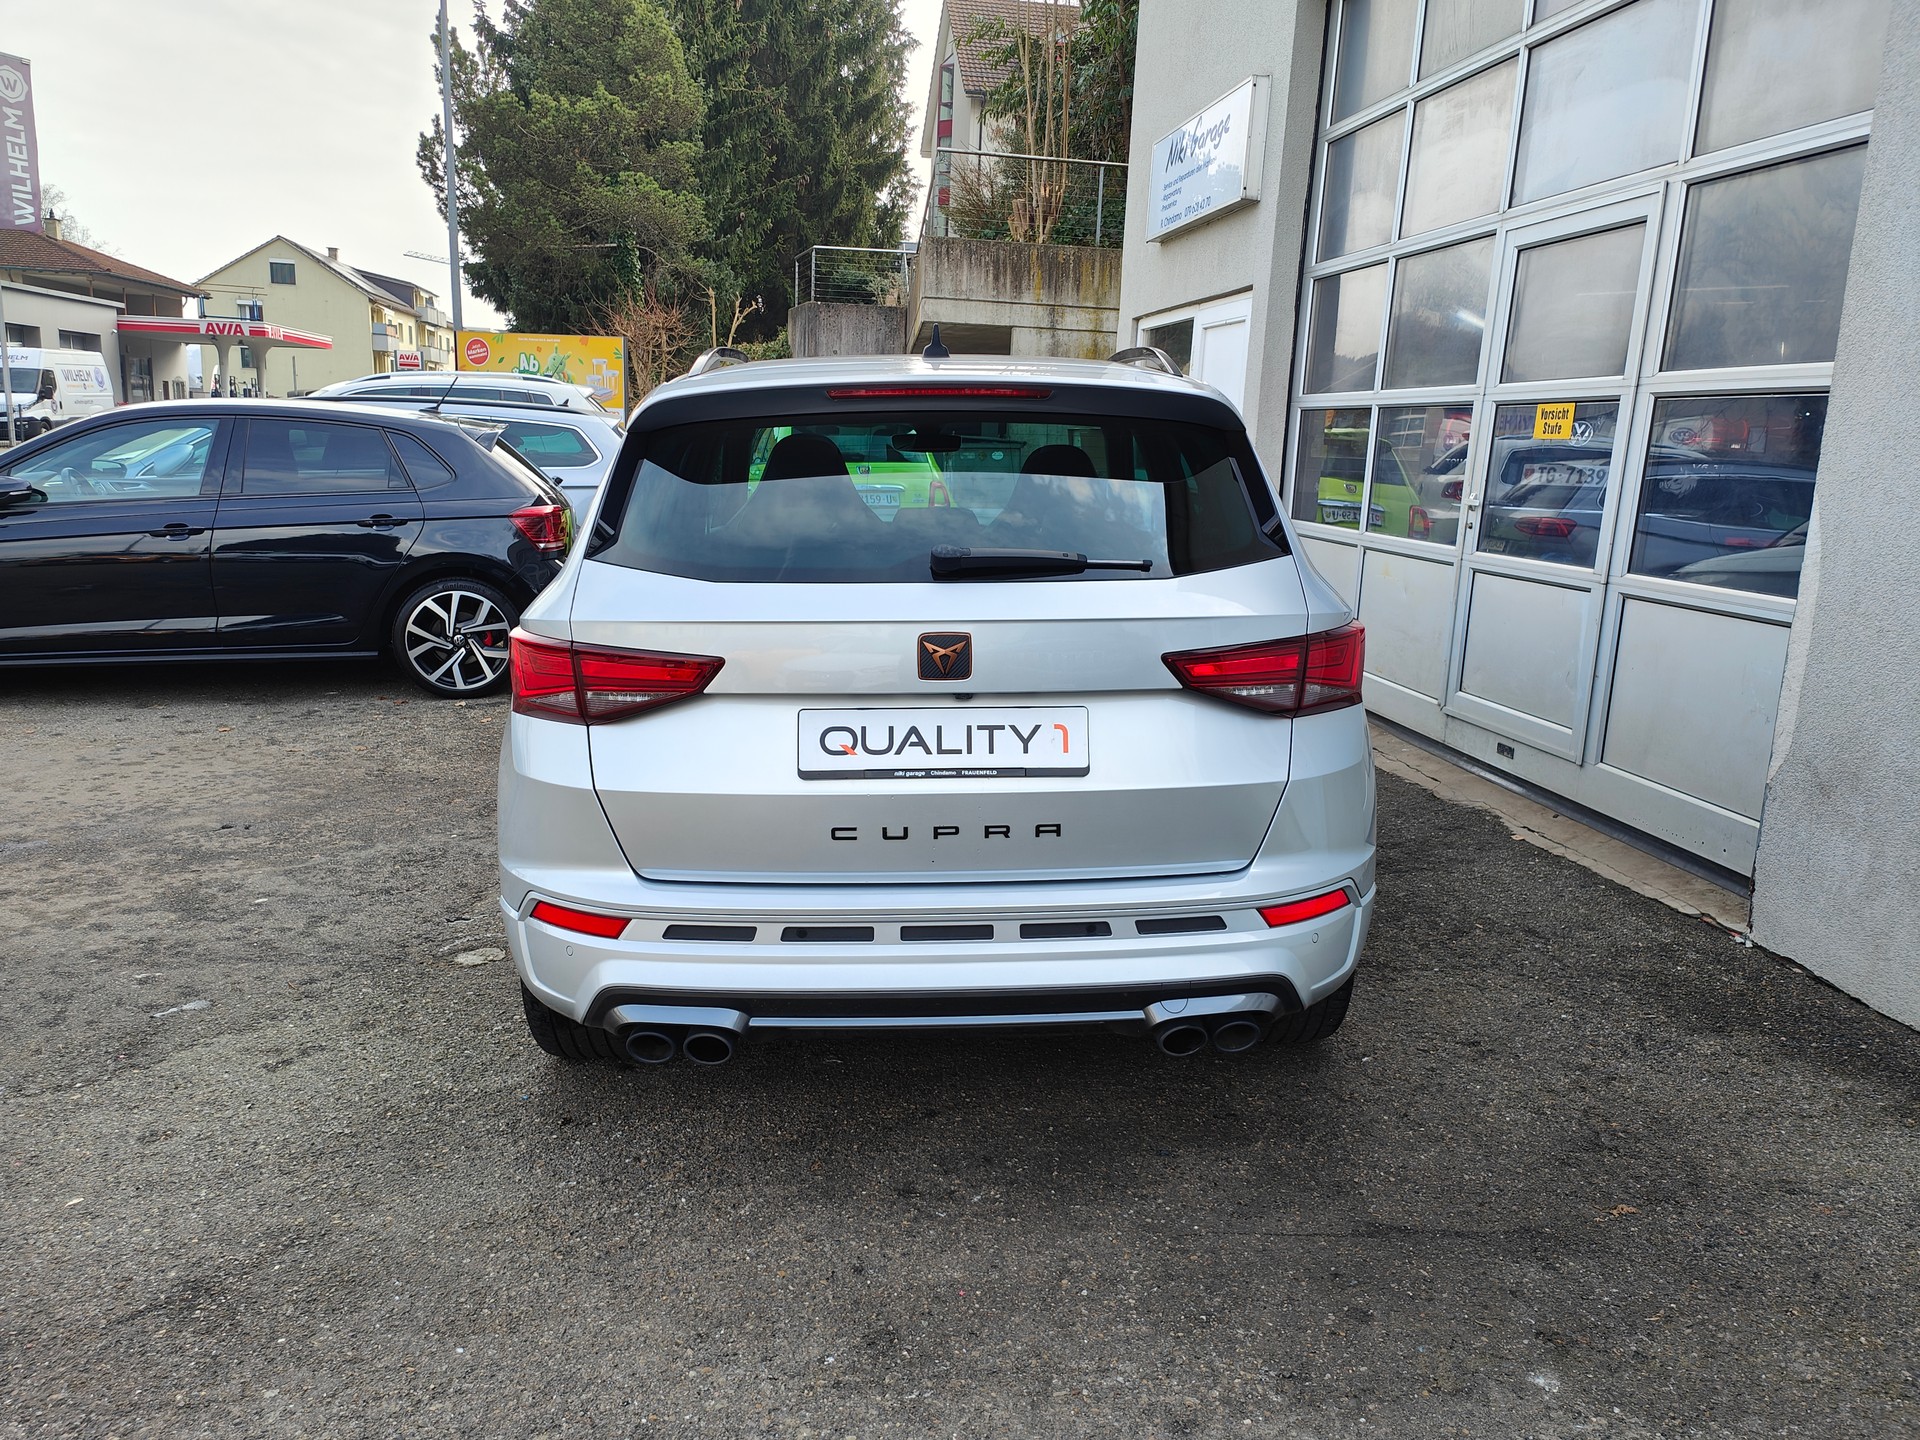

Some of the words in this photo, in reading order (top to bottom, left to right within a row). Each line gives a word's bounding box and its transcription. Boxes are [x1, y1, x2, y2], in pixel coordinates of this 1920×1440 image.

[1166, 130, 1190, 173] Niki
[1191, 114, 1230, 157] Garage
[2, 106, 36, 225] WILHELM
[205, 322, 245, 336] AVIA
[399, 353, 419, 361] AVIA
[519, 353, 540, 372] Ab
[61, 369, 93, 382] WILHELM
[1541, 408, 1570, 420] Vorsicht
[1542, 421, 1562, 434] Stufe
[1538, 466, 1556, 484] TG
[819, 724, 1042, 756] QUALITY
[831, 823, 1062, 841] CUPRA
